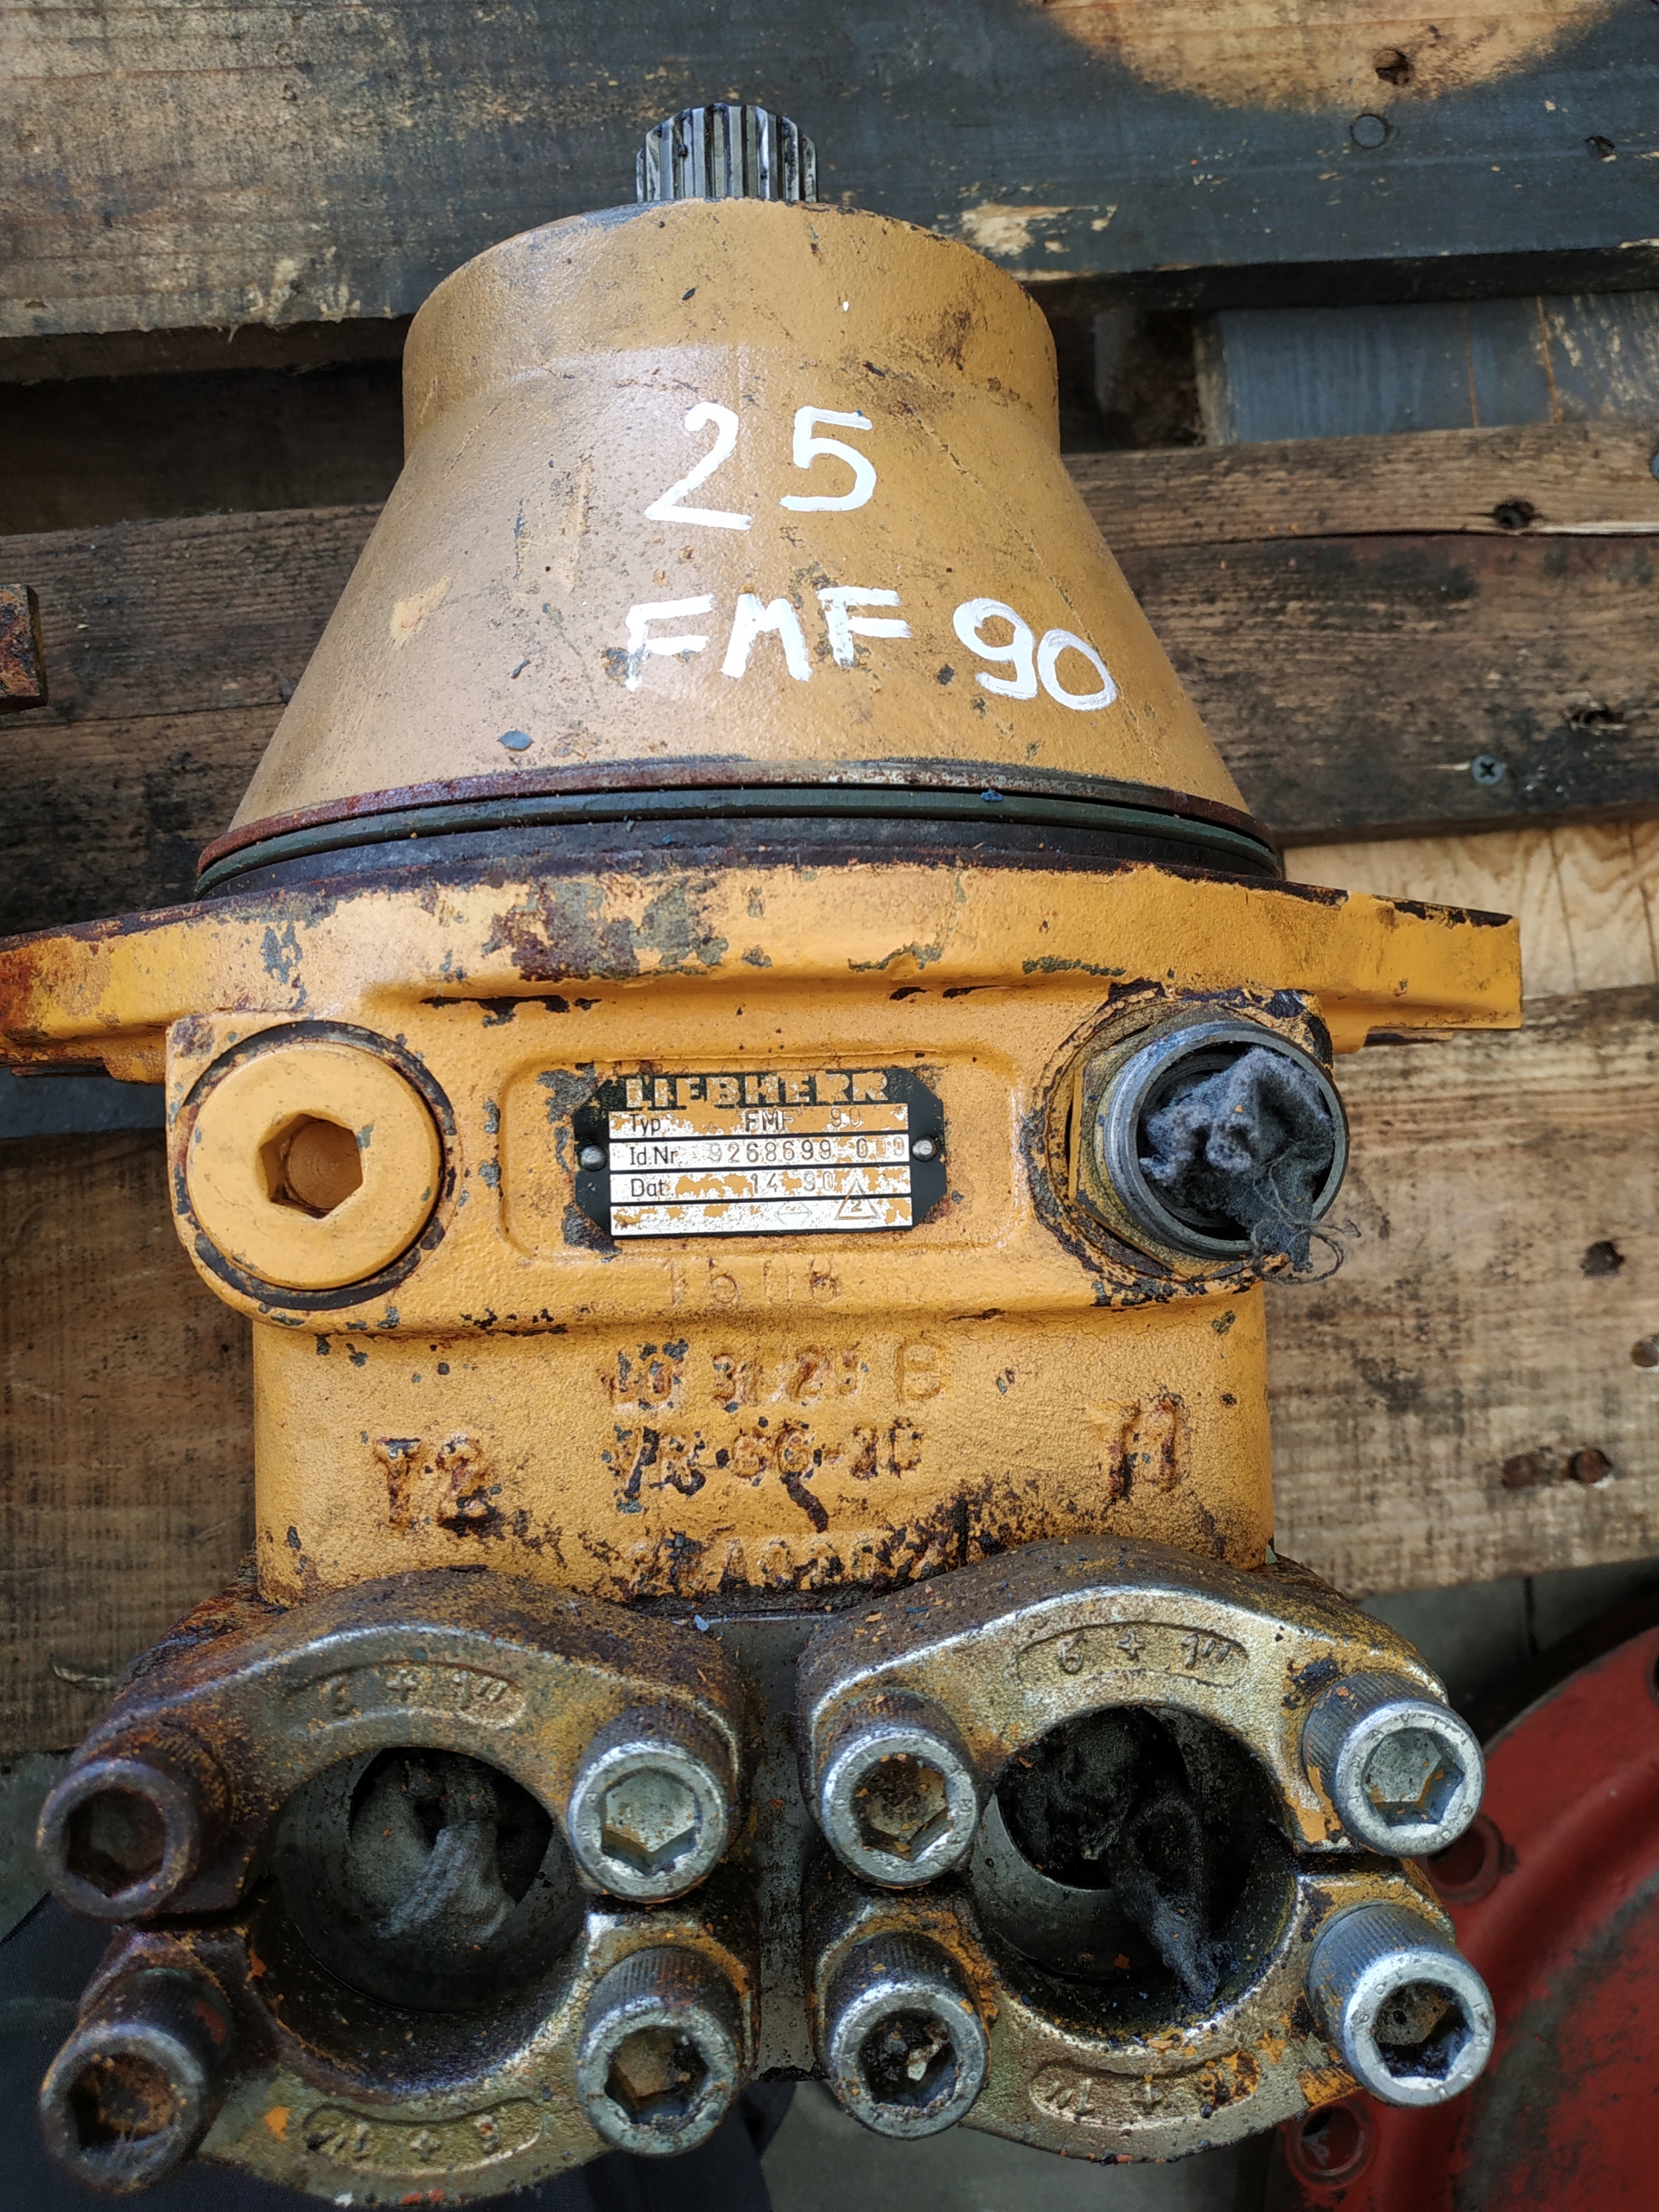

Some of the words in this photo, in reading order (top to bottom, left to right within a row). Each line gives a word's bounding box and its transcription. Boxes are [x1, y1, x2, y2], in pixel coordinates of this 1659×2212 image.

[645, 402, 877, 531] 25
[625, 586, 912, 692] FMF
[952, 597, 1118, 711] 90
[626, 1071, 889, 1109] LIEBHERR
[830, 1108, 861, 1128] 90
[709, 1138, 832, 1165] 9268699
